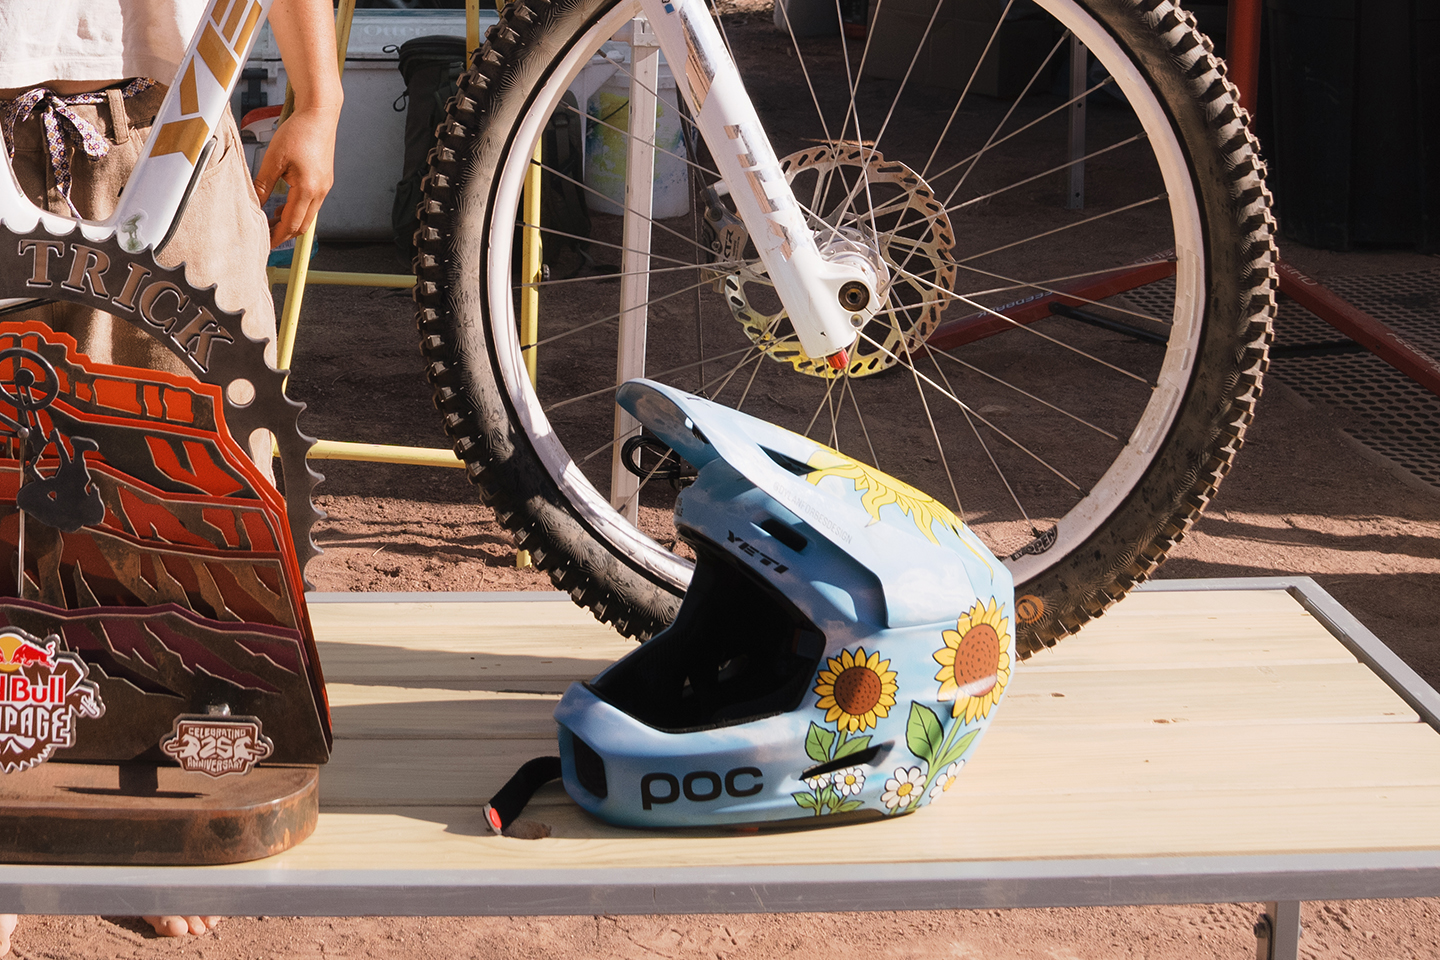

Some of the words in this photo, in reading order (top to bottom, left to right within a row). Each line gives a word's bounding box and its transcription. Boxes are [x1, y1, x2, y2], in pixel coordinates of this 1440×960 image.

[18, 239, 234, 373] TRICK
[727, 529, 789, 574] YETI
[1026, 528, 1057, 554] OPEN
[11, 674, 64, 703] Bull
[188, 727, 246, 739] CELEBRATING
[200, 736, 233, 759] 25
[187, 757, 245, 772] ANNIVERSARY
